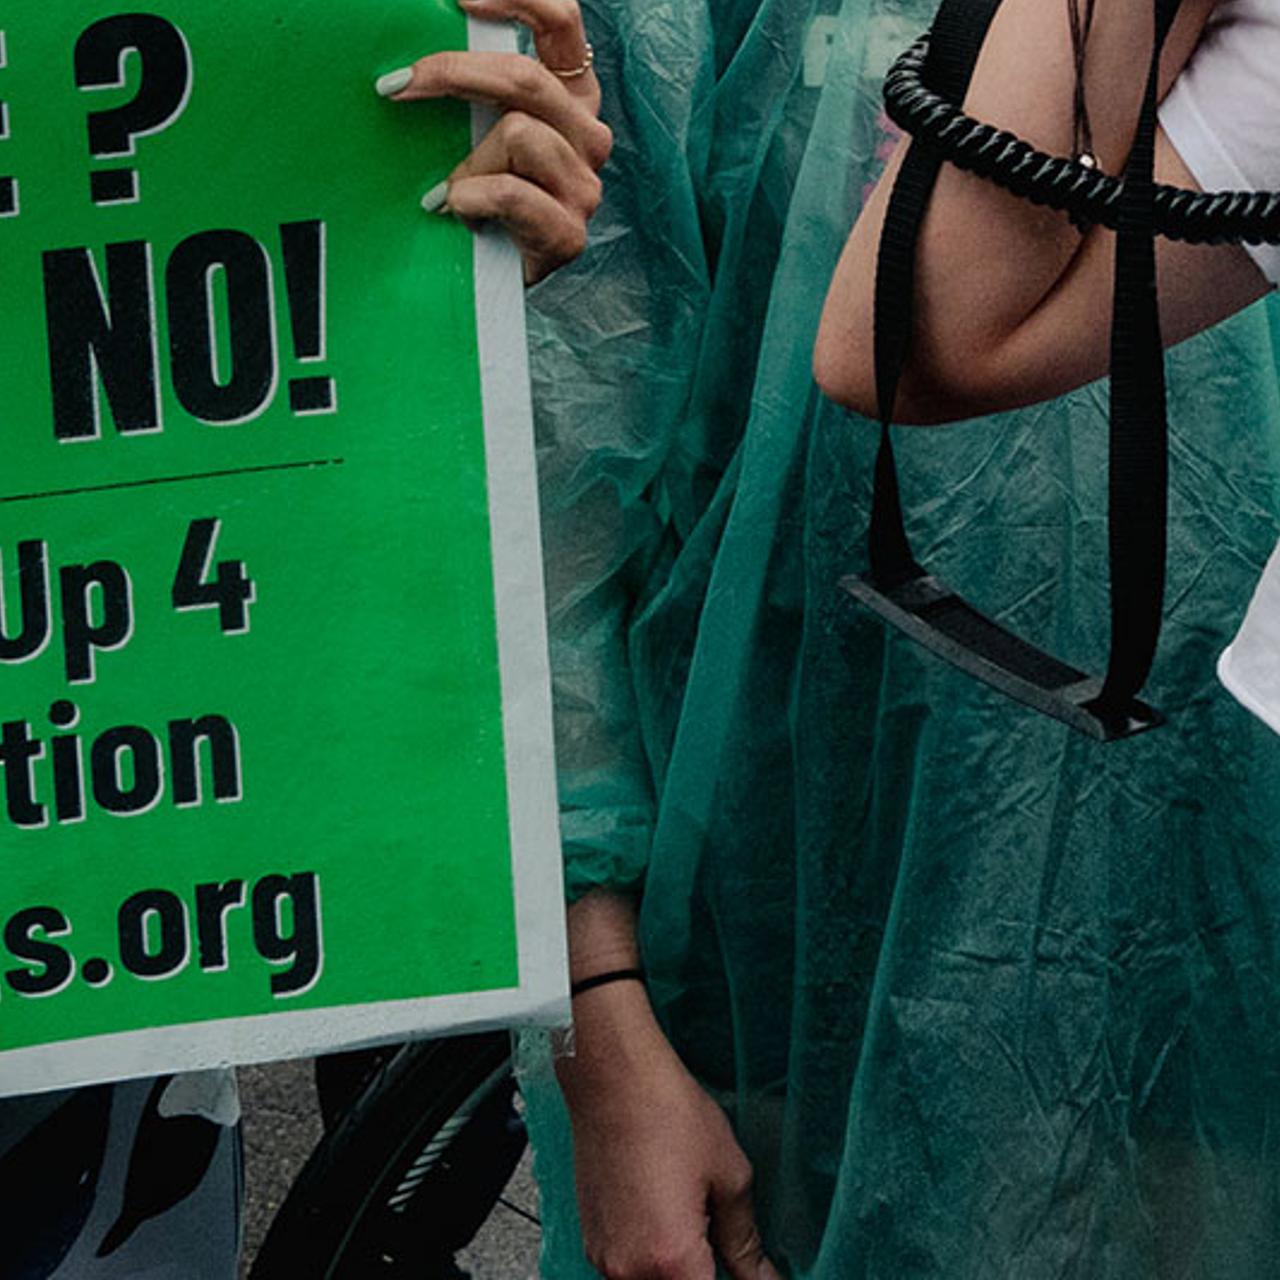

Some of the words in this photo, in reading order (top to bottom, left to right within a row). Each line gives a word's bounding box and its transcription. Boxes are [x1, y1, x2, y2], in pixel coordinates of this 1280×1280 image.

[41, 219, 338, 443] NO!
[0, 539, 135, 685] Up
[171, 516, 257, 636] 4
[0, 697, 244, 830] tion
[2, 870, 325, 1000] s.org
